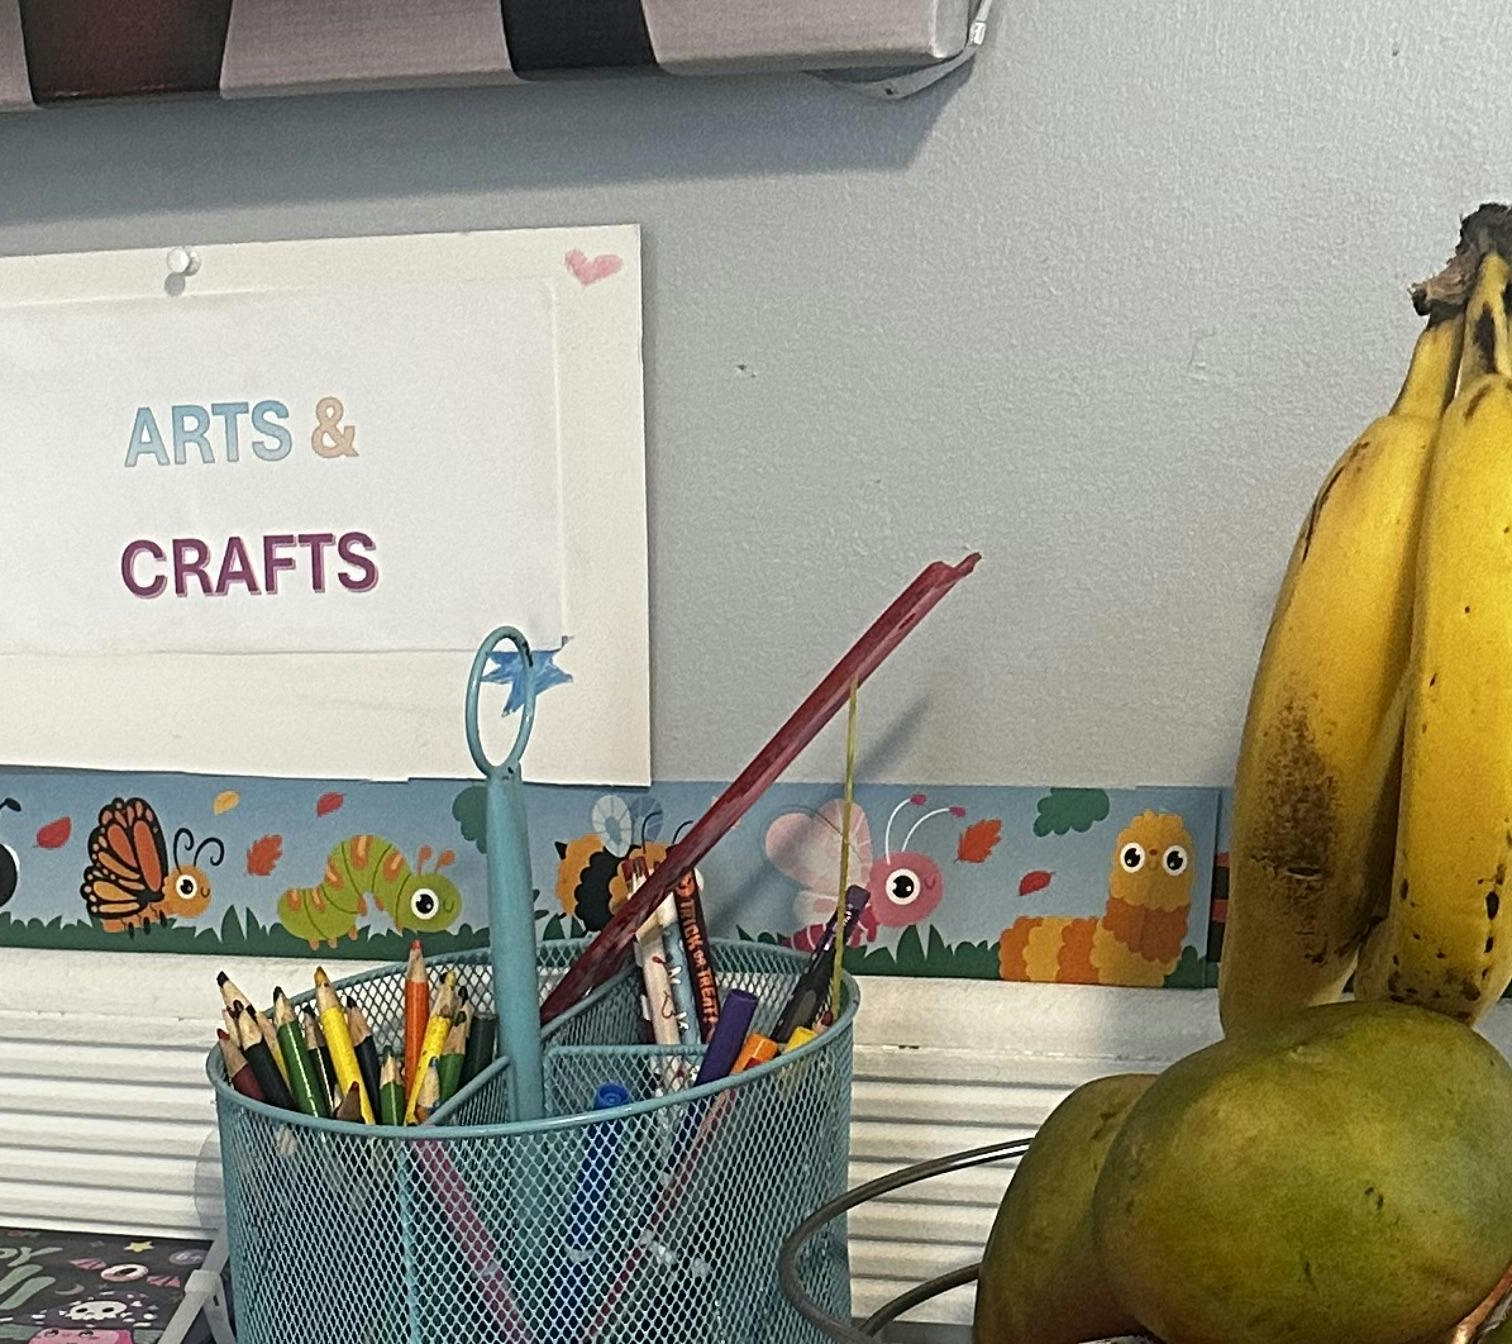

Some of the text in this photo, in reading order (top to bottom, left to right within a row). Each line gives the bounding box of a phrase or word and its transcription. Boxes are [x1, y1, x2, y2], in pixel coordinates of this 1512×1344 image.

[124, 395, 360, 468] ARTS &
[120, 531, 380, 600] CRAFTS
